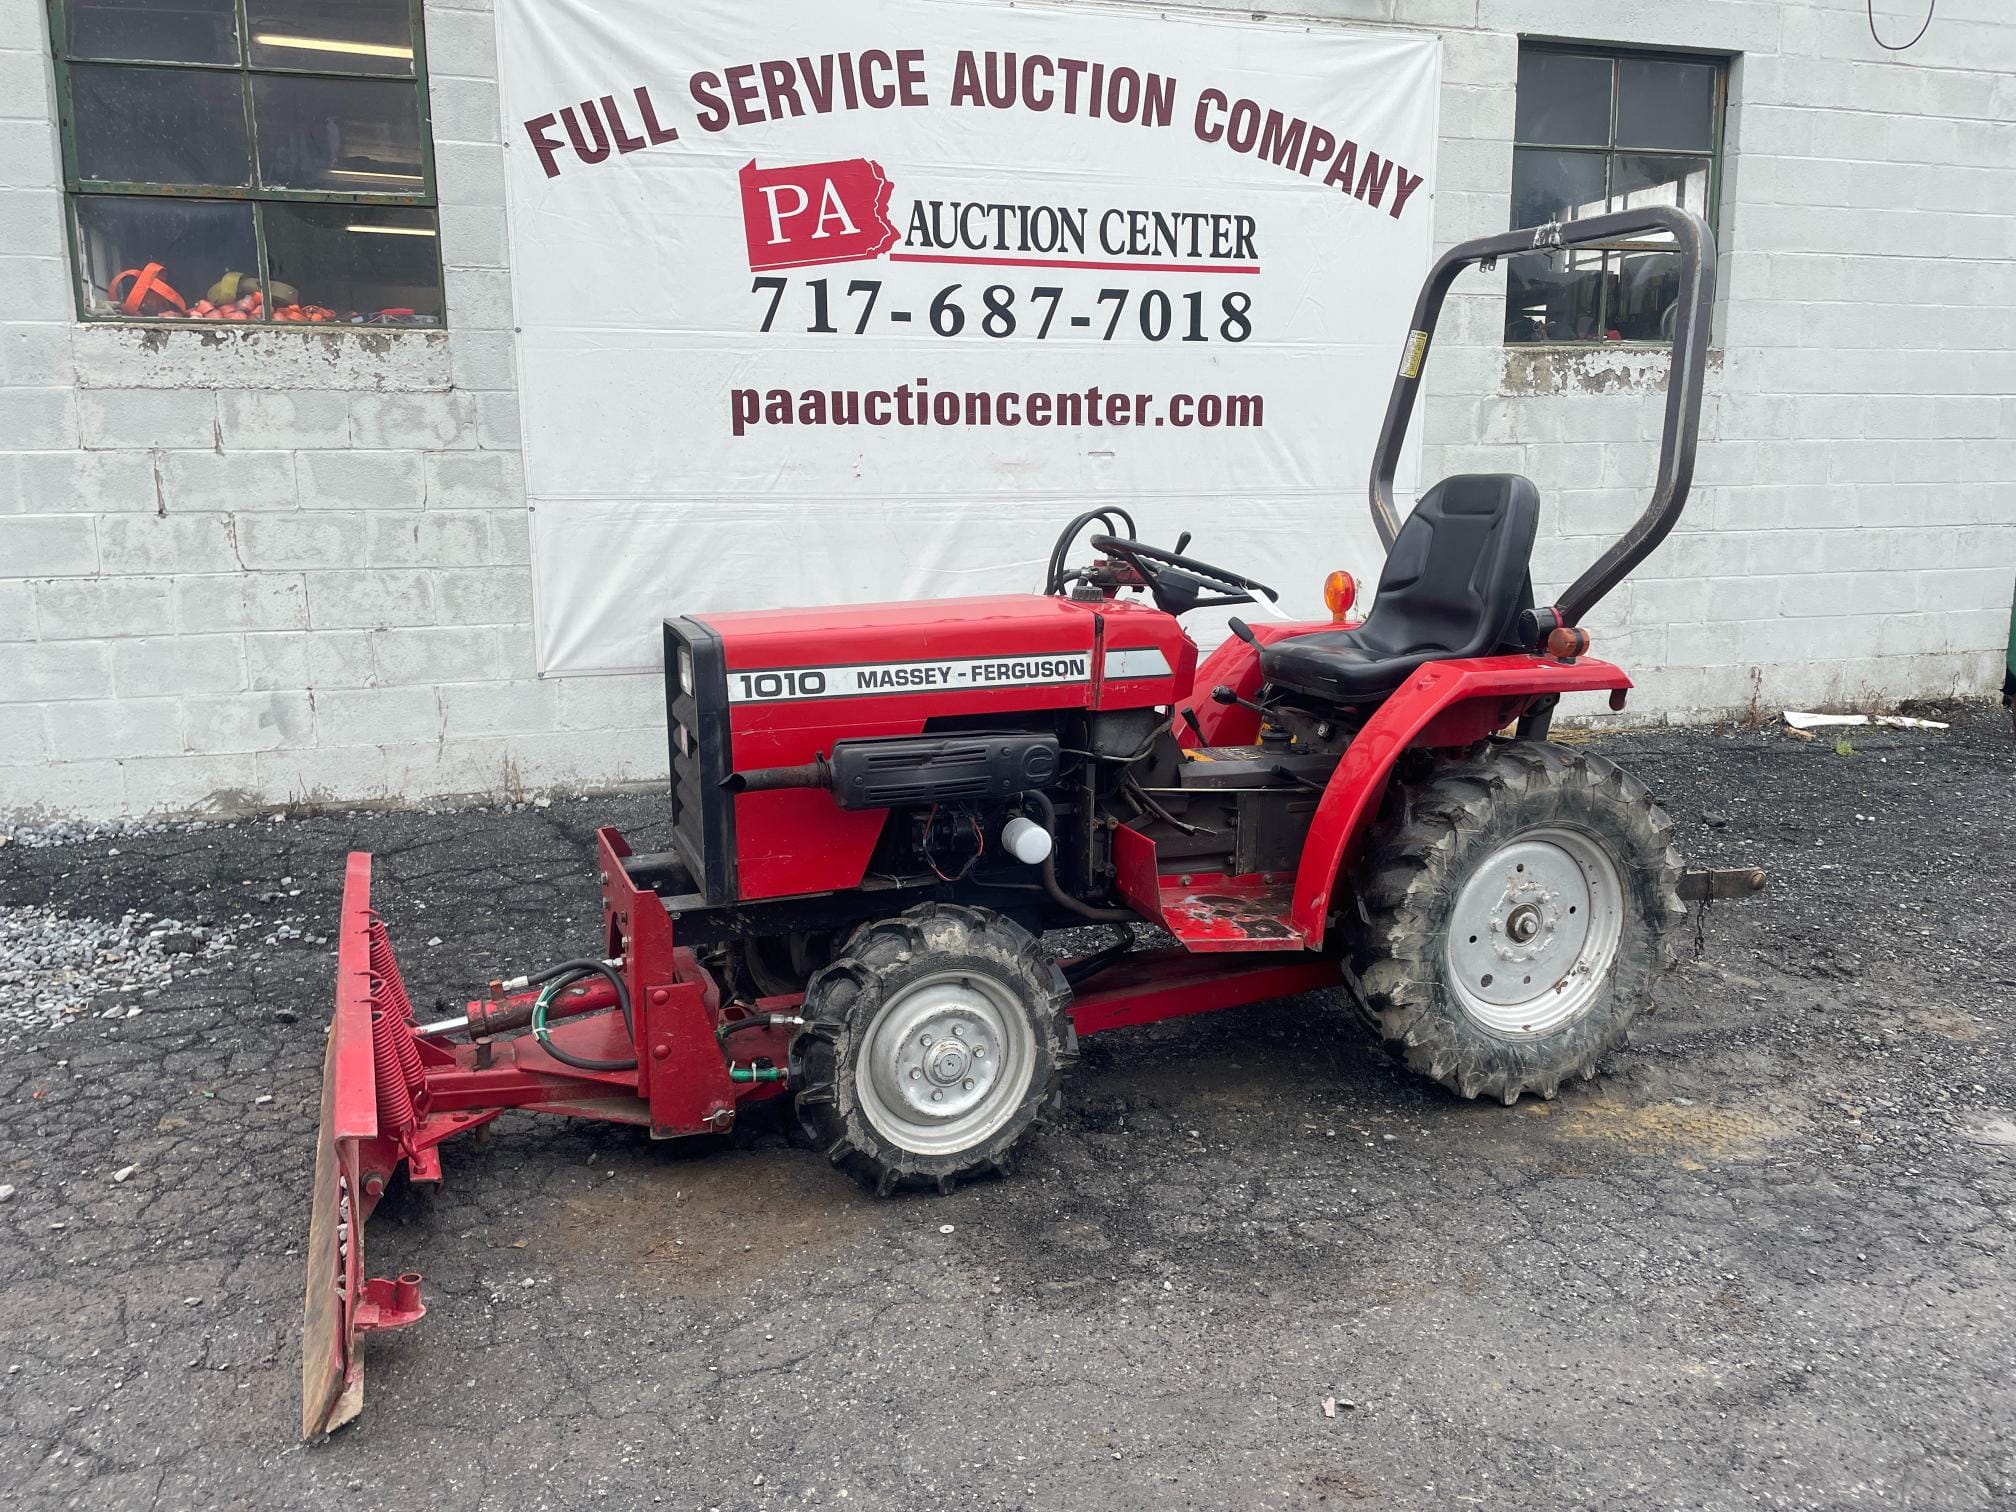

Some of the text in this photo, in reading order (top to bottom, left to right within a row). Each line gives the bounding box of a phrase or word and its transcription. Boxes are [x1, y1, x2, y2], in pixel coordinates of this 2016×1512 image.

[524, 49, 1423, 219] FULL SERVICE AUCTION COMPANY
[758, 178, 1259, 259] PA AUCTION CENTER
[751, 276, 1252, 342] 717-687-7018
[731, 378, 1264, 436] paauctioncenter.com
[740, 671, 827, 699] 1010
